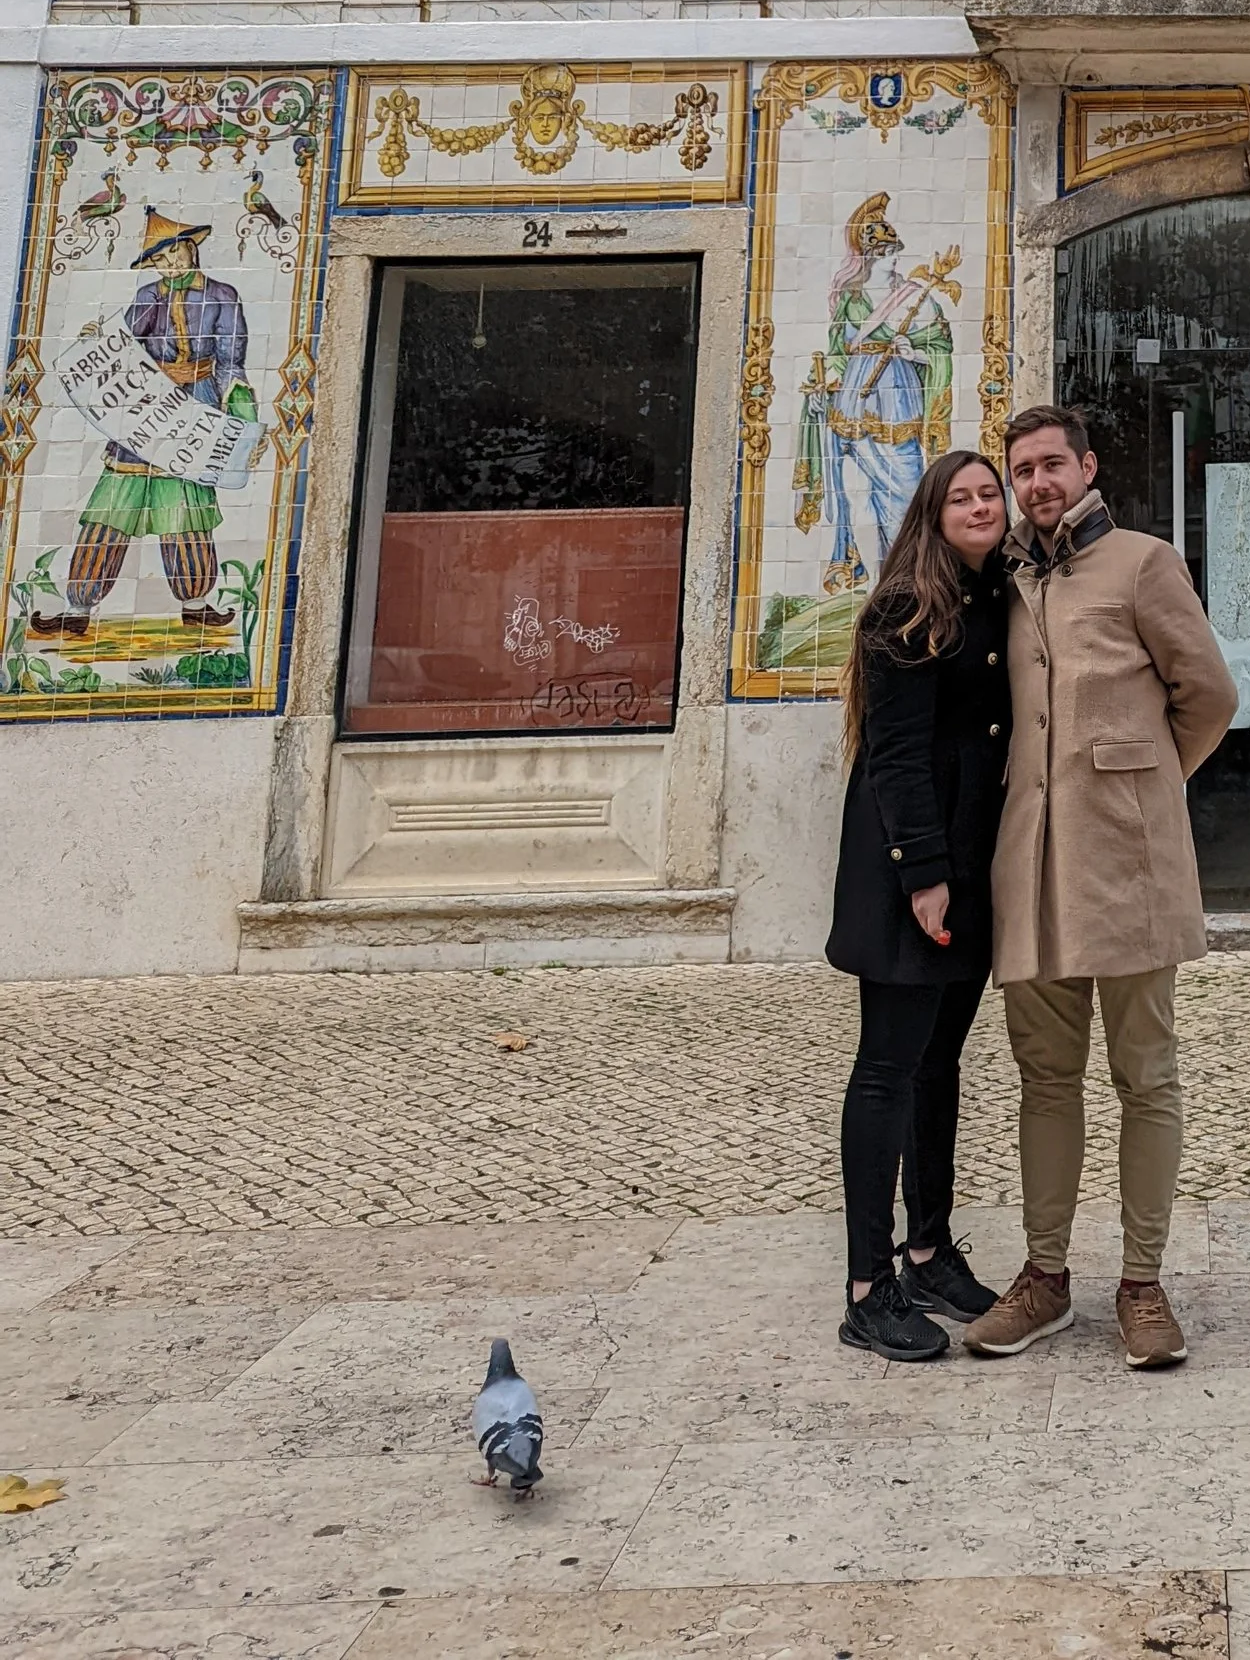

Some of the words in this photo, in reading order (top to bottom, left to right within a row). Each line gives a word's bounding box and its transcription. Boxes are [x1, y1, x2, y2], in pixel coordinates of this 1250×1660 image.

[522, 220, 553, 248] 24
[60, 327, 134, 394] FABRICA
[87, 360, 160, 422] LOIÇA
[96, 358, 123, 389] DE
[126, 386, 190, 455] ANTONIO
[127, 393, 158, 417] DE
[169, 409, 223, 476] COSTA
